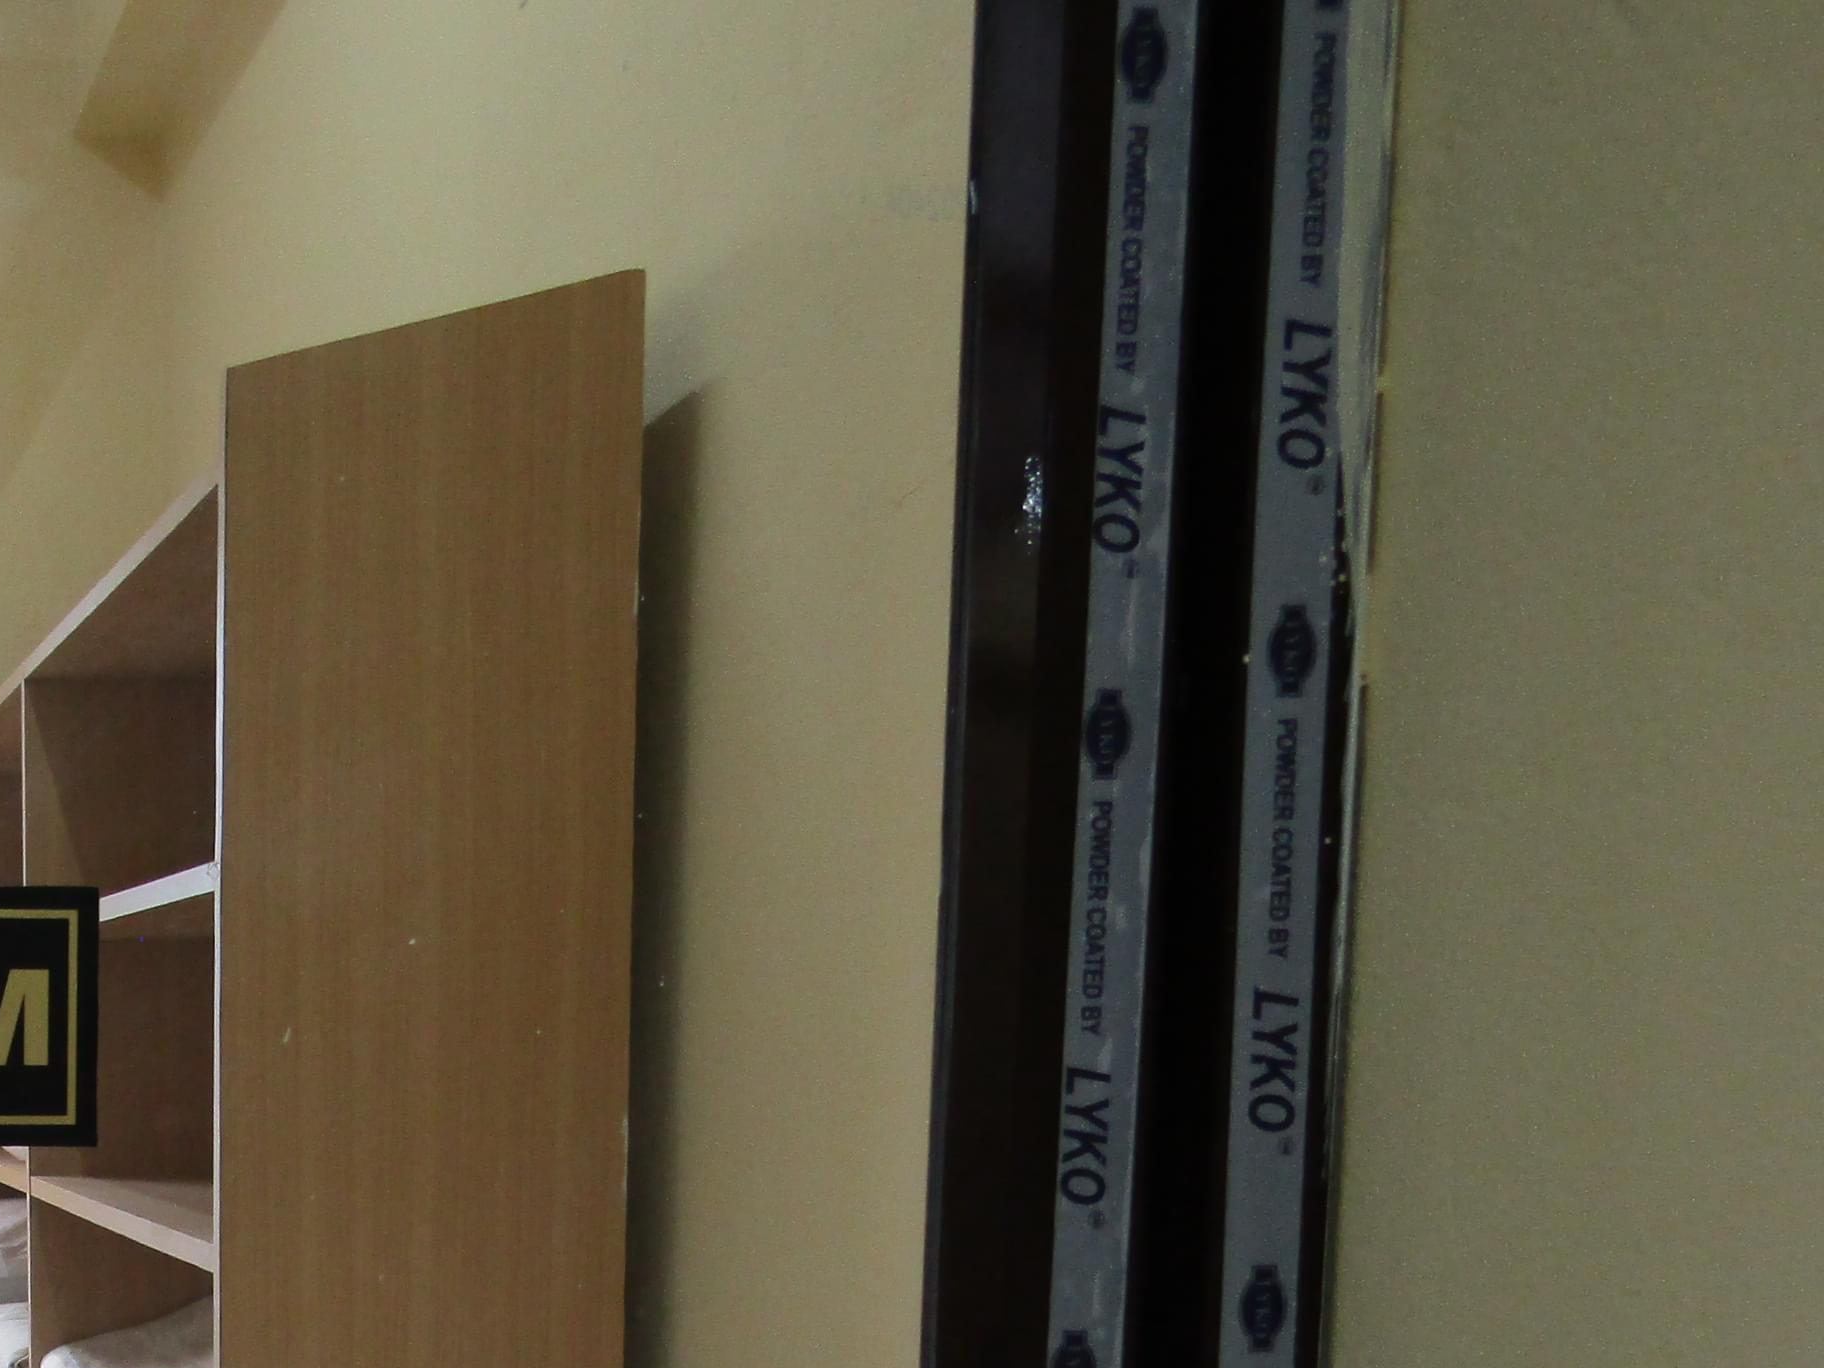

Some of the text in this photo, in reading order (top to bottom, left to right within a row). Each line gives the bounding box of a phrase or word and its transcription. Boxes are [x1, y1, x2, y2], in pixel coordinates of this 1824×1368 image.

[1092, 124, 1150, 555] POWDER COATED BY LYKO
[1276, 32, 1336, 470] POWDER COATED BY LYKO
[1059, 800, 1114, 1206] POWDER COATED BY LYKO
[1248, 718, 1300, 1133] POWDER COATED BY LYKO
